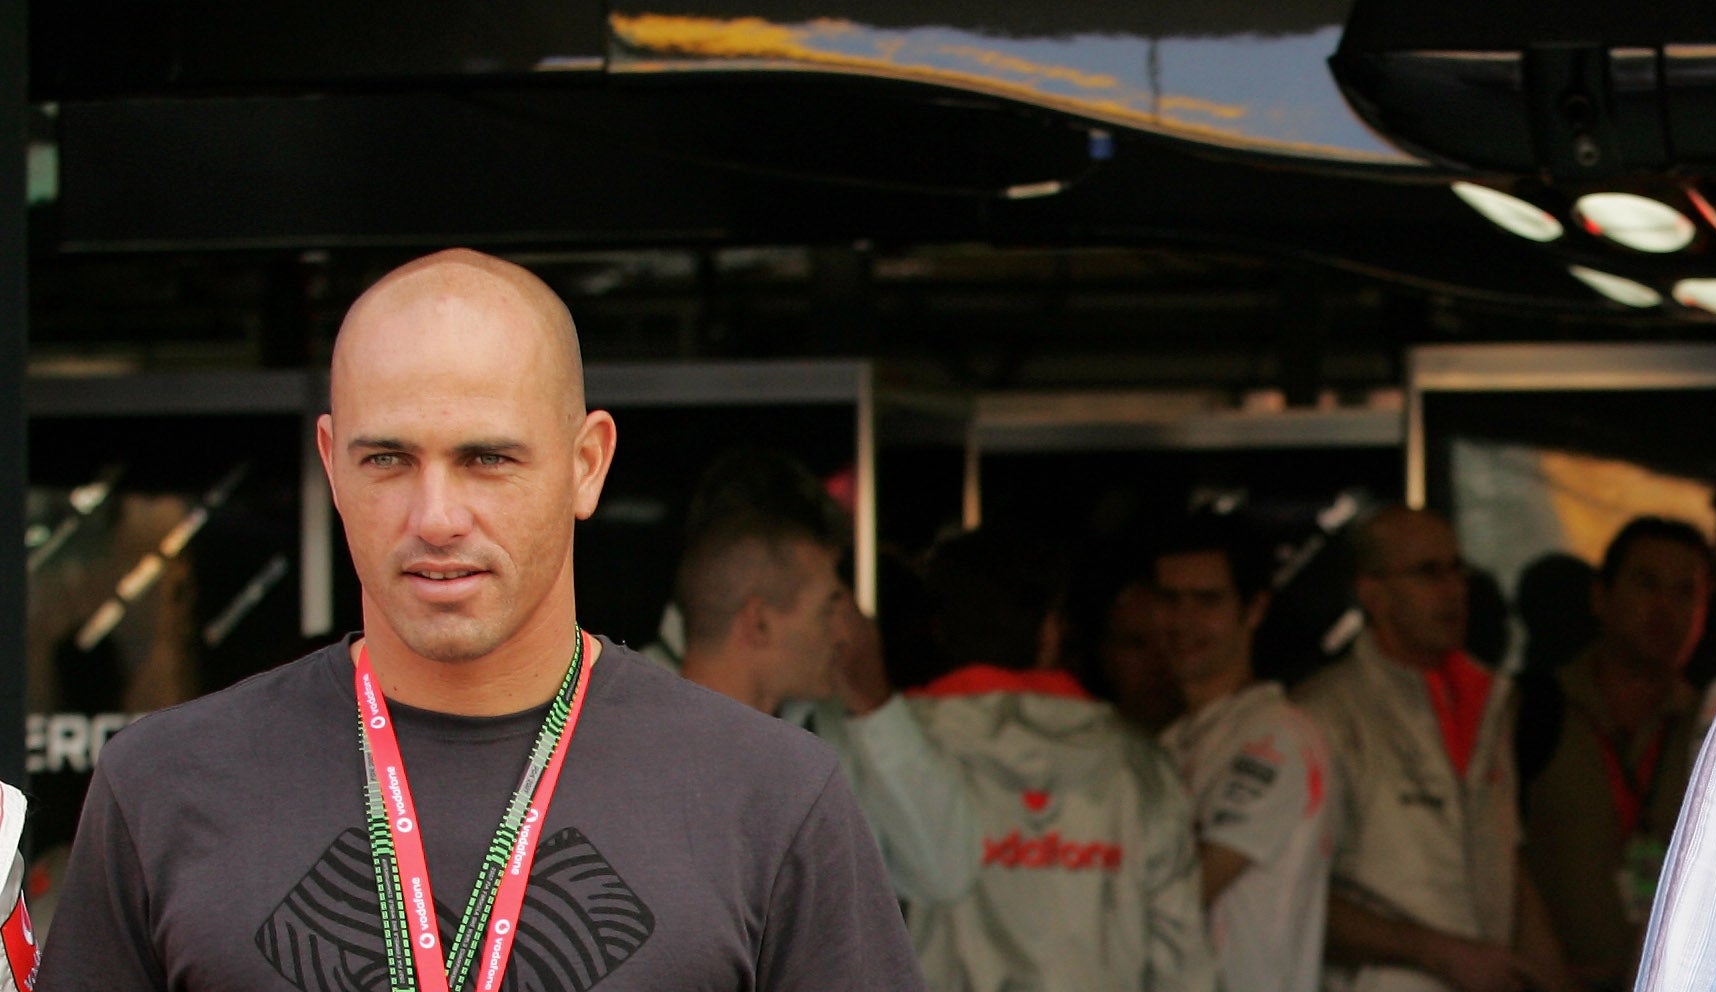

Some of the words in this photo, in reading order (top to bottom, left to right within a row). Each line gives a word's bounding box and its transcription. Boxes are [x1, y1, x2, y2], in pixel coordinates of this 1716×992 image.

[364, 673, 379, 715] vodafone
[387, 765, 404, 816] vodafone
[510, 820, 533, 876] vodafone
[412, 876, 429, 931] vodafone
[484, 937, 504, 991] vodafone
